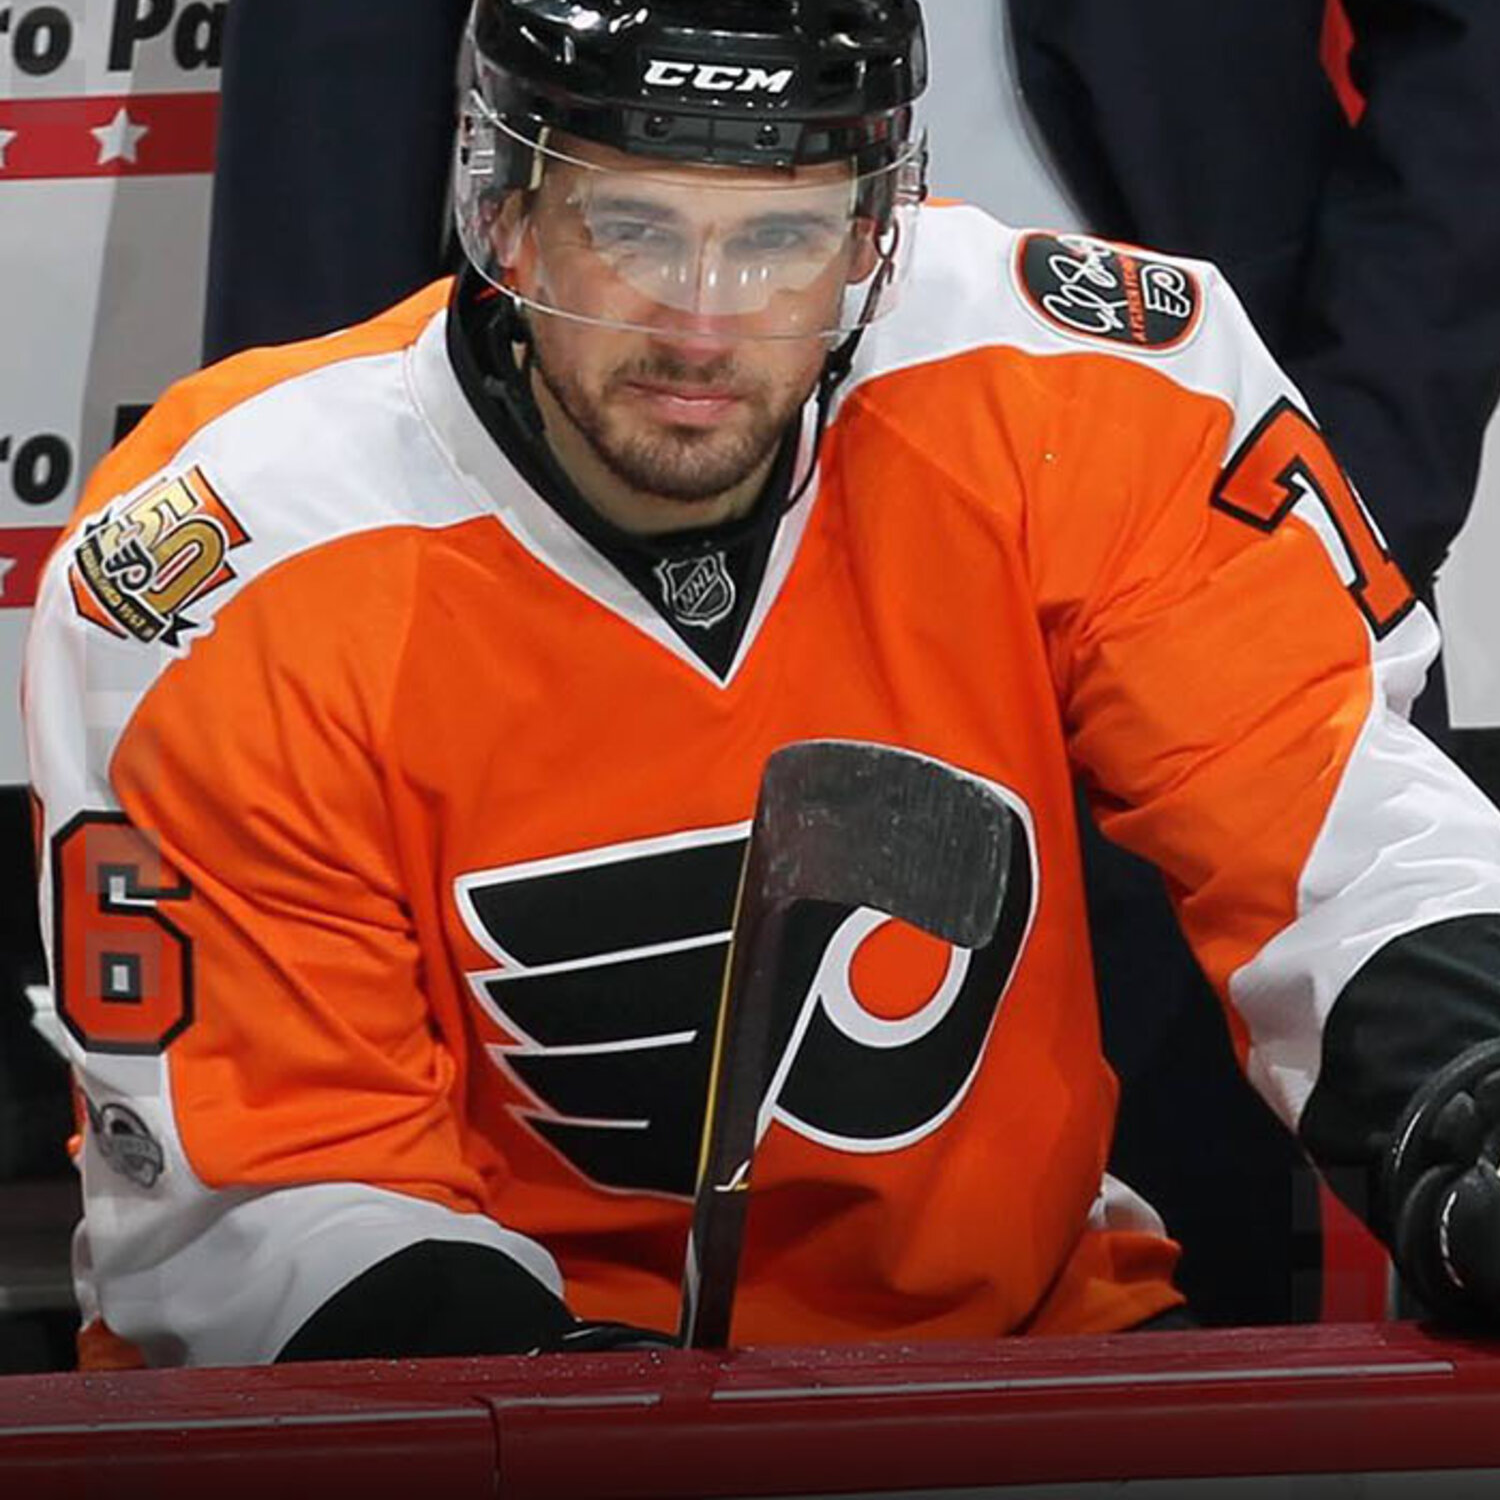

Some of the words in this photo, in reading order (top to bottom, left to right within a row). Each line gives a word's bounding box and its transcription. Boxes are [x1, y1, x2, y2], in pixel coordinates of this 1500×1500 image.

[643, 60, 793, 93] CCM
[1210, 395, 1417, 641] 7
[51, 810, 196, 1056] 6
